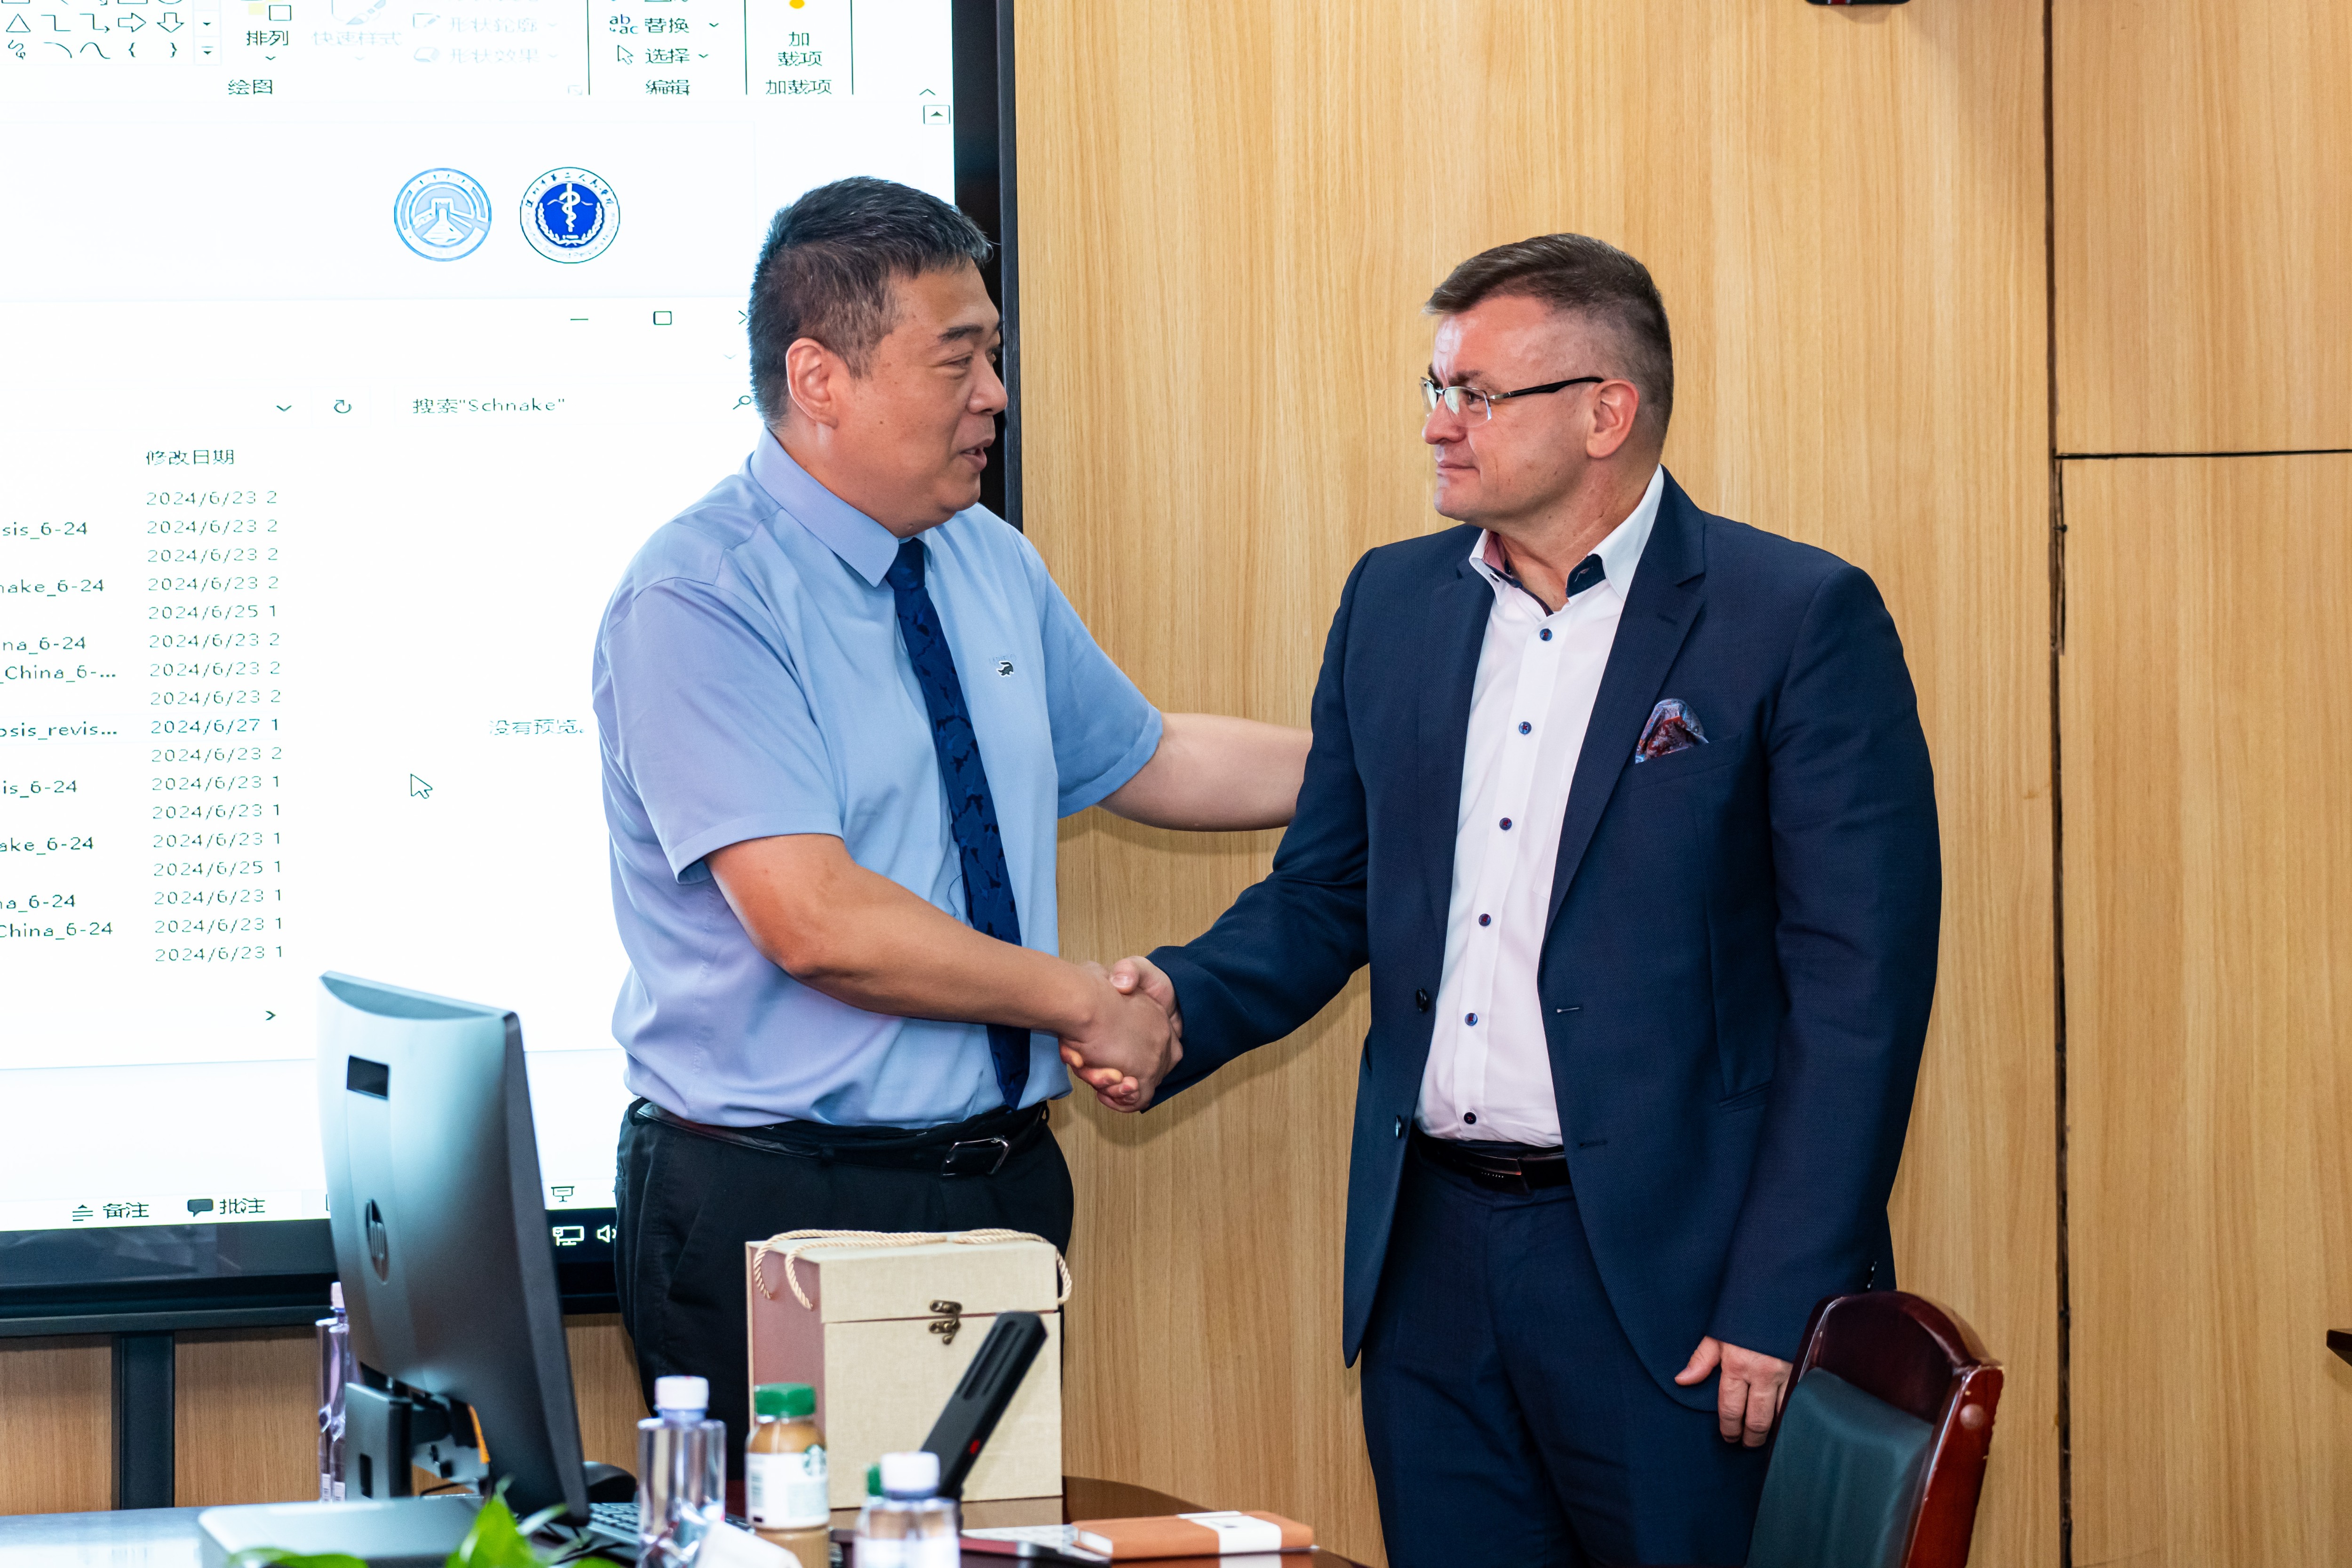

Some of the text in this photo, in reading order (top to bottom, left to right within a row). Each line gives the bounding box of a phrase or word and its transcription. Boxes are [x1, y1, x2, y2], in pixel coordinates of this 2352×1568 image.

[644, 17, 690, 33] 替换
[246, 30, 289, 46] 排列
[311, 31, 401, 45] 快速样式
[788, 32, 810, 47] 加
[452, 48, 537, 64] 形状效果
[645, 48, 690, 64] 选择
[228, 79, 273, 95] 绘图
[645, 80, 691, 96] 编辑
[765, 80, 832, 95] 加载项
[146, 449, 234, 465] 修改日期
[147, 491, 256, 507] 2024/6/23
[2, 522, 87, 540] sis_6-24
[147, 519, 256, 535] 2024/6/23
[148, 548, 257, 564] 2024/6/23
[149, 577, 257, 592] 2024/6/23
[149, 605, 258, 621] 2024/6/25
[3, 637, 86, 655] na_6-24
[150, 633, 258, 649] 2024/6/23
[151, 662, 259, 678] 2024/6/23
[151, 690, 260, 707] 2024/6/23
[151, 718, 260, 735] 2024/6/27
[152, 748, 261, 764] 2024/6/23
[3, 780, 77, 798] is_6-24
[152, 776, 261, 792] 2024/6/23
[153, 804, 262, 820] 2024/6/23
[153, 832, 262, 849] 2024/6/23
[154, 861, 263, 877] 2024/6/25
[0, 894, 76, 913] a_6-24
[154, 889, 264, 906] 2024/6/23
[155, 918, 264, 934] 2024/6/23
[156, 946, 265, 963] 2024/6/23
[103, 1202, 149, 1219] 备注
[219, 1198, 265, 1215] 批注
